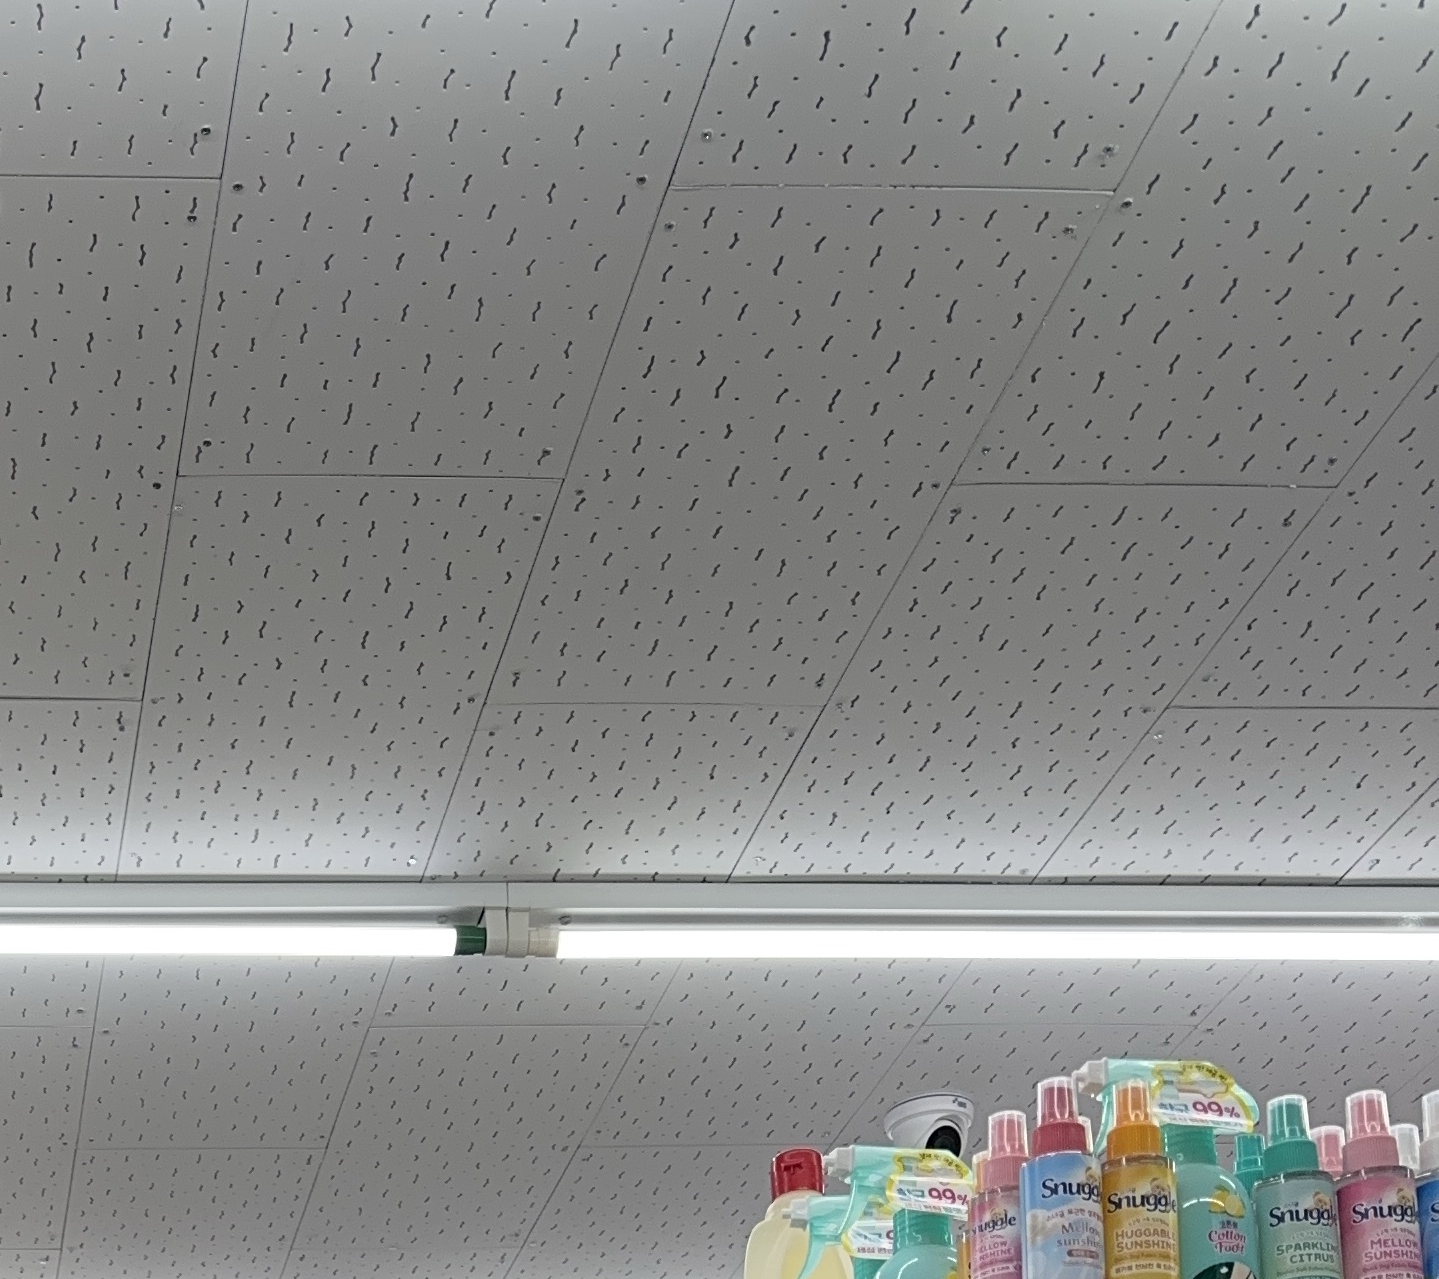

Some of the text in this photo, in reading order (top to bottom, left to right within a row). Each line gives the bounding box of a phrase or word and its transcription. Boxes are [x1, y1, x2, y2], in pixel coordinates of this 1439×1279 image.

[1192, 1101, 1241, 1119] 99%
[1041, 1178, 1102, 1203] Snugg
[1107, 1191, 1178, 1215] Snuggle
